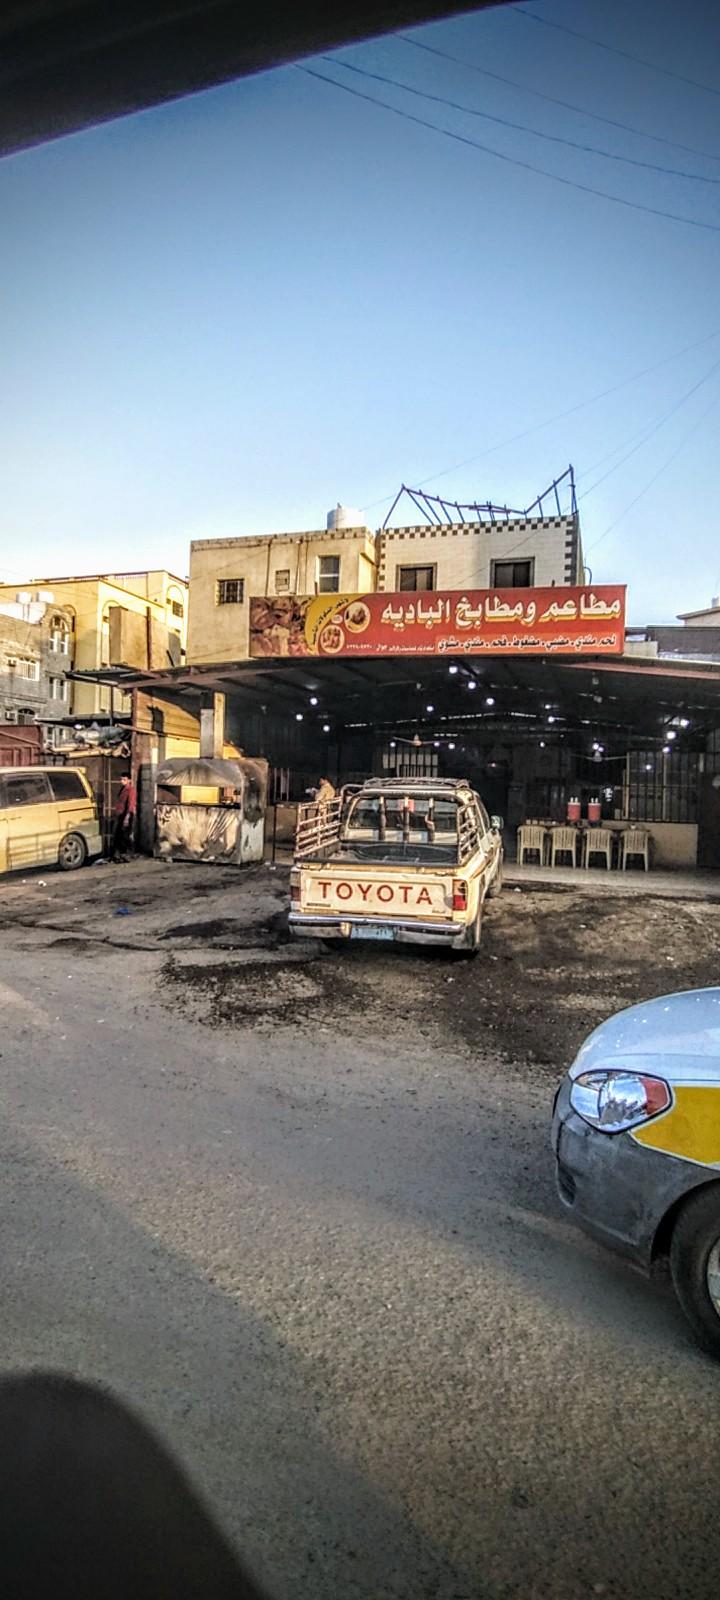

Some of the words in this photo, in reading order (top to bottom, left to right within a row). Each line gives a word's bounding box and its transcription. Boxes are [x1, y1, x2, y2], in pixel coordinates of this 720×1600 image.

[380, 597, 451, 631] الباديه
[455, 595, 537, 630] ومطابخ
[539, 593, 622, 624] مطاعم
[318, 881, 433, 906] TOYOTA
